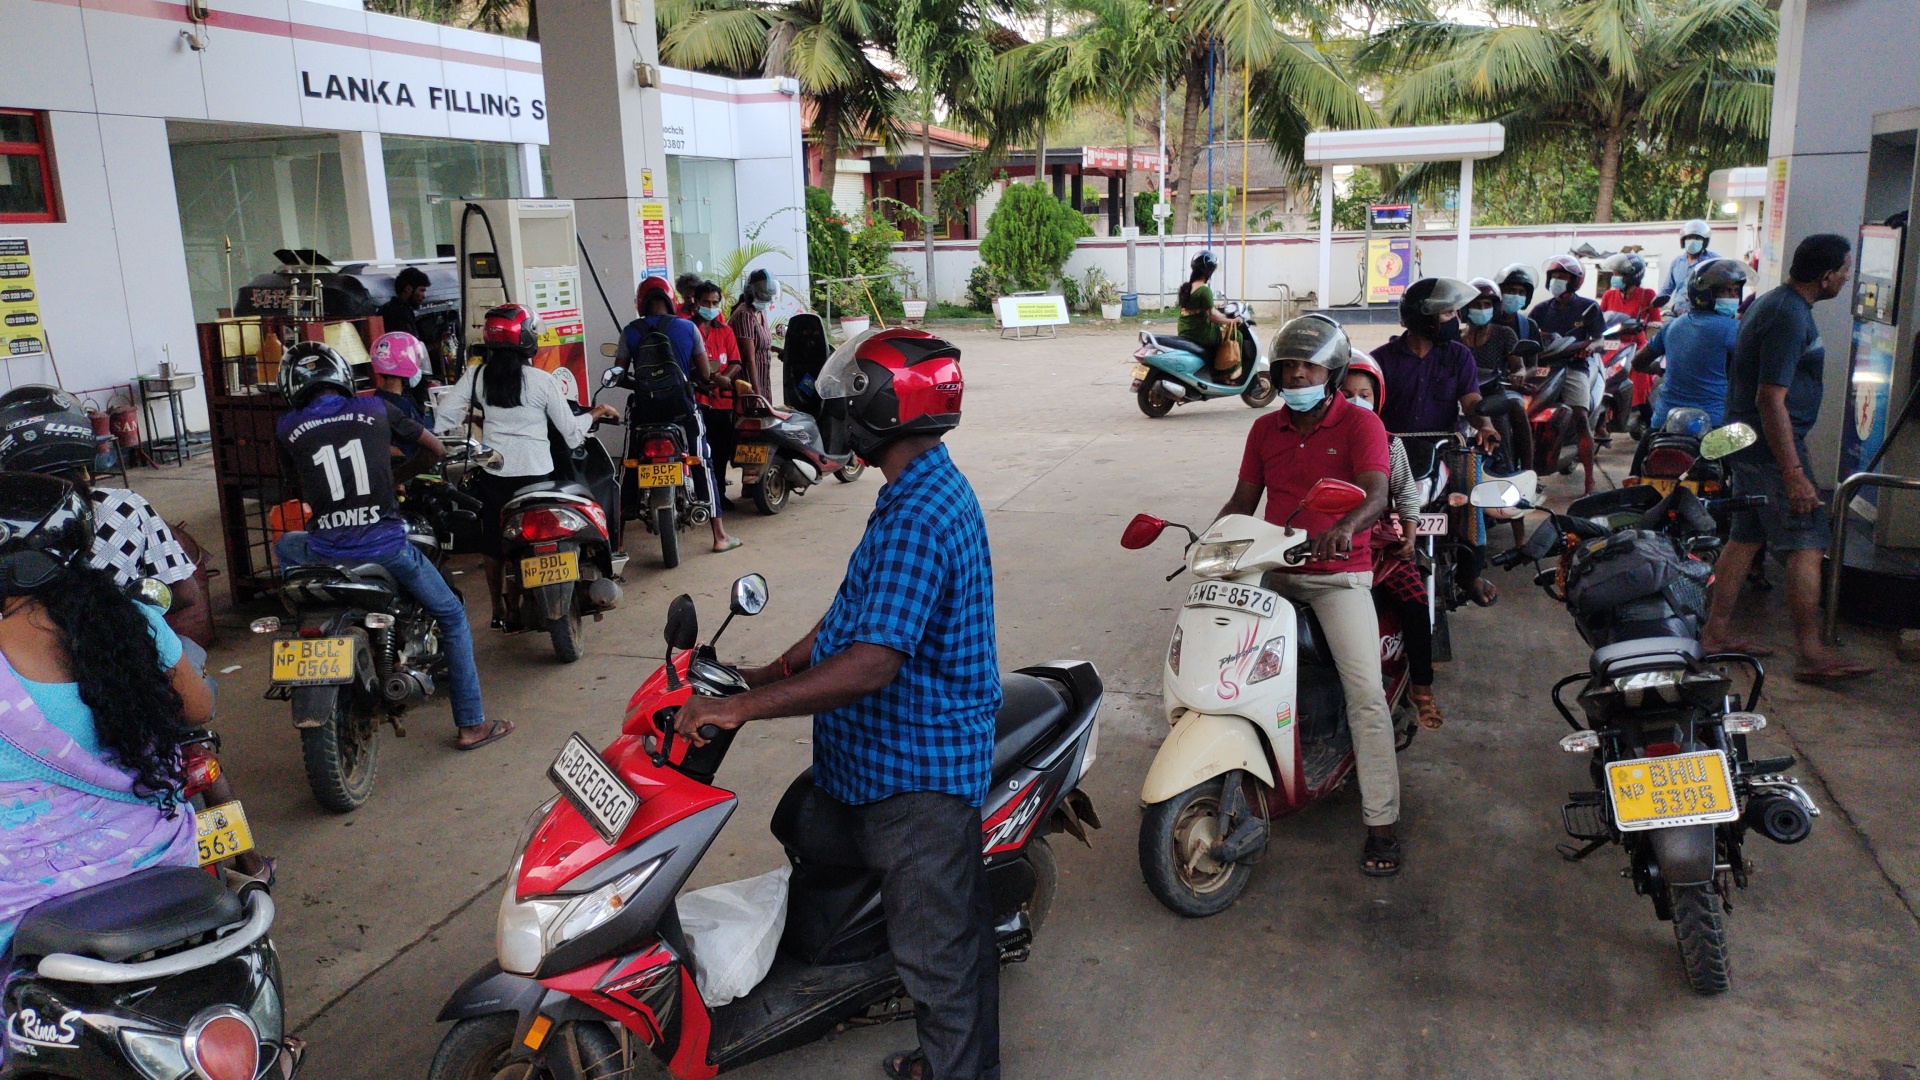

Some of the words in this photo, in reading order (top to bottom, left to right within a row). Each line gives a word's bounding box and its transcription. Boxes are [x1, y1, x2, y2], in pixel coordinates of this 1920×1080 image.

[302, 71, 416, 108] LANKA
[429, 87, 521, 118] FILLING
[532, 100, 546, 121] S
[663, 126, 684, 135] ochchi
[312, 438, 371, 502] 11
[640, 472, 651, 480] NP
[653, 464, 675, 476] BCP
[652, 474, 676, 486] 7535
[317, 505, 381, 530] KONES
[1419, 518, 1444, 532] 277
[540, 555, 567, 569] BDL
[524, 568, 538, 578] NP
[301, 641, 340, 659] BCL
[276, 654, 295, 667] NP
[297, 659, 340, 677] 0564
[557, 751, 574, 771] NP
[1649, 758, 1708, 788] BHU
[1619, 782, 1645, 802] NP
[1651, 785, 1716, 815] 5395
[197, 809, 229, 837] JB
[198, 830, 239, 861] 563
